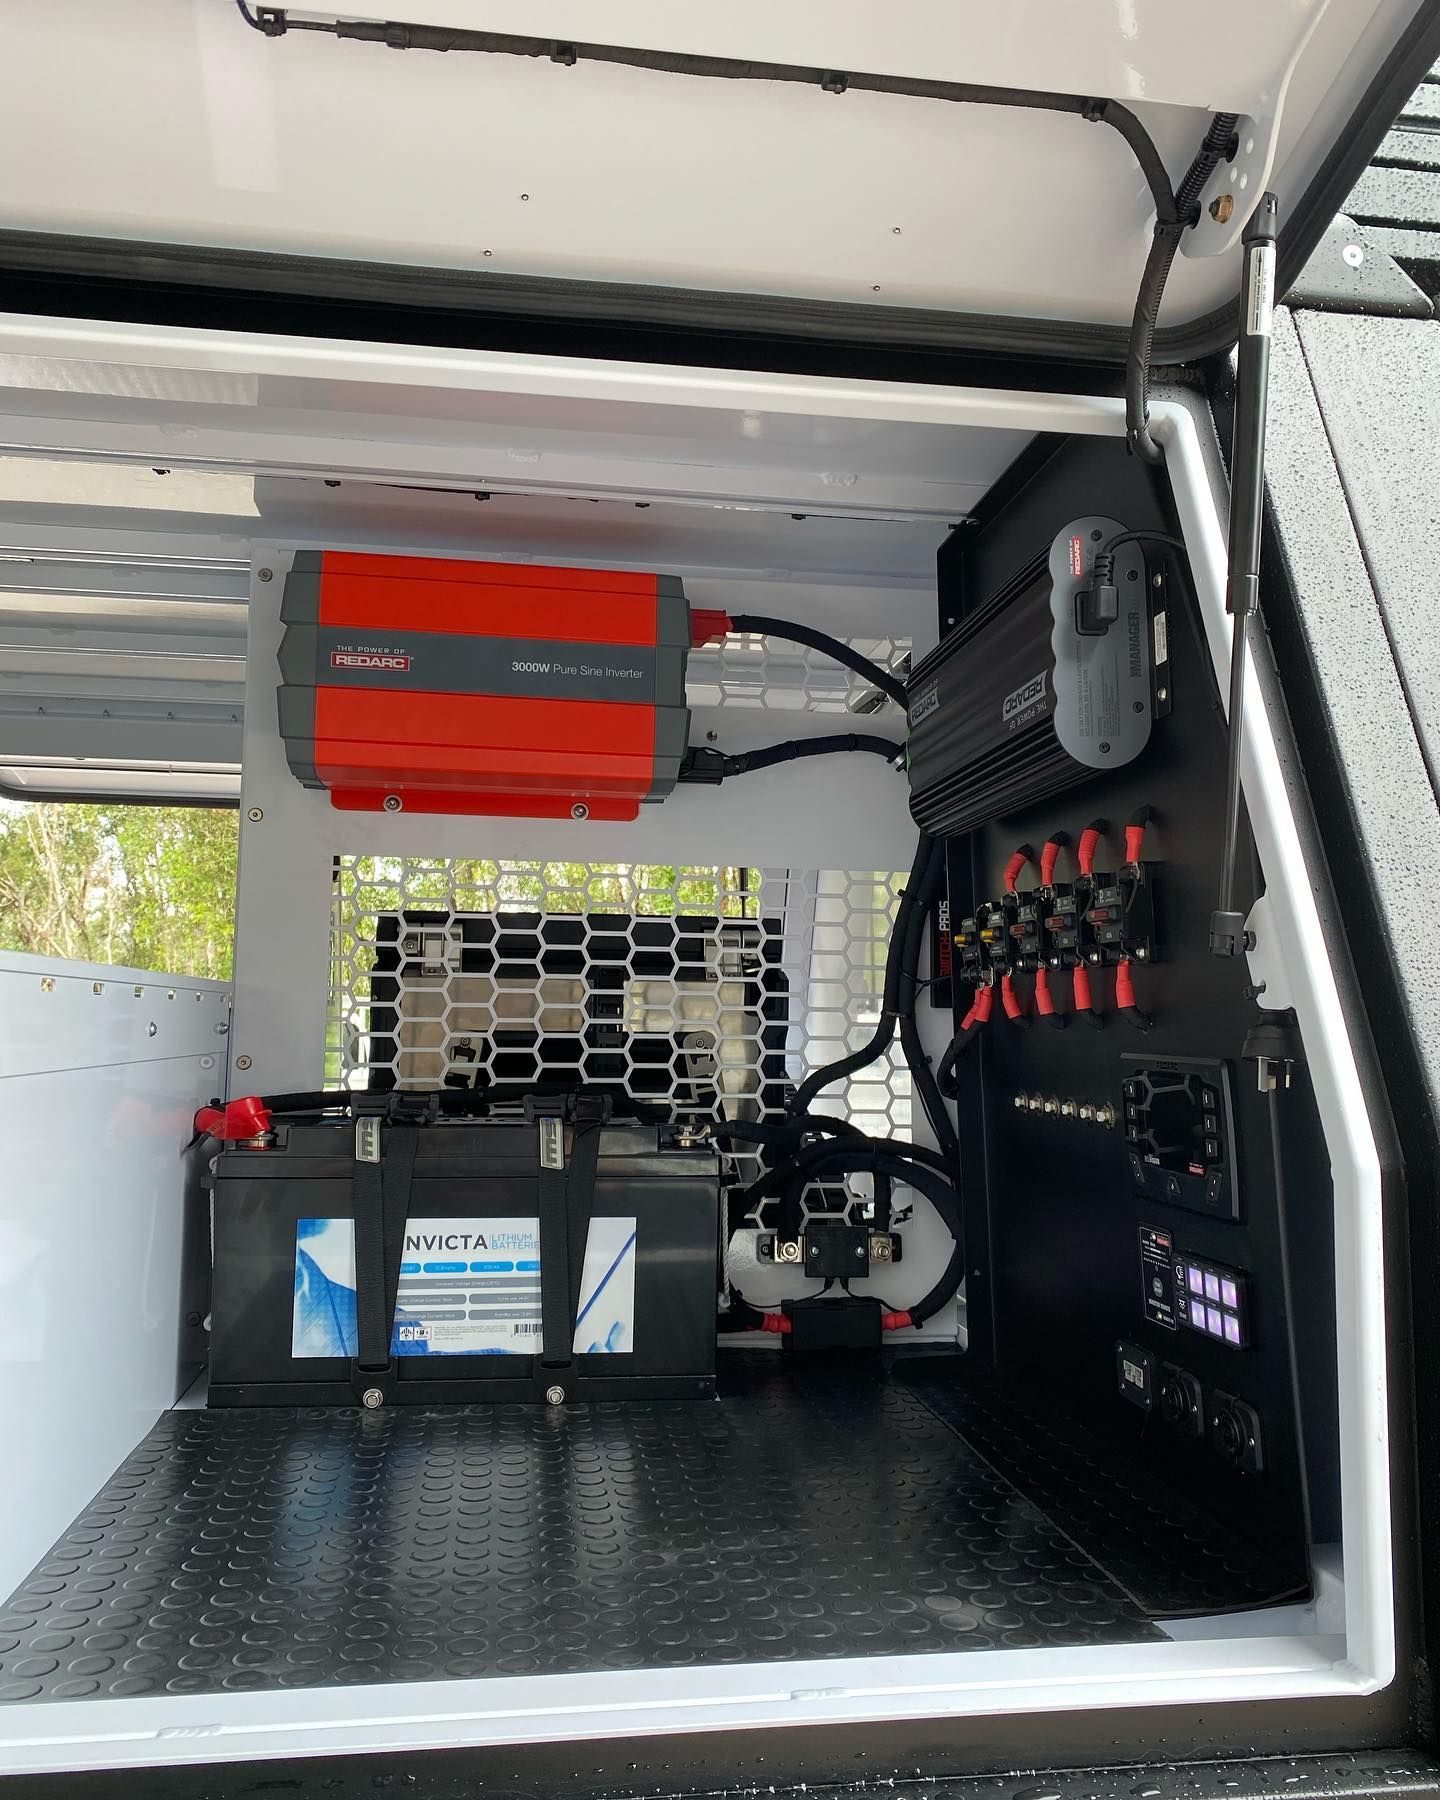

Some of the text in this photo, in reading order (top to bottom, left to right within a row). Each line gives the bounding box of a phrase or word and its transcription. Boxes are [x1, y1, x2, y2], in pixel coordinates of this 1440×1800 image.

[1073, 539, 1081, 575] REDARC
[357, 646, 390, 654] POWER
[335, 654, 406, 669] REDARC
[511, 661, 643, 679] 3000W Pure Sine Inverter
[1004, 676, 1043, 715] REDARC
[406, 1233, 533, 1250] NVICTA LITHIUM
[491, 1240, 540, 1250] BATTERIE
